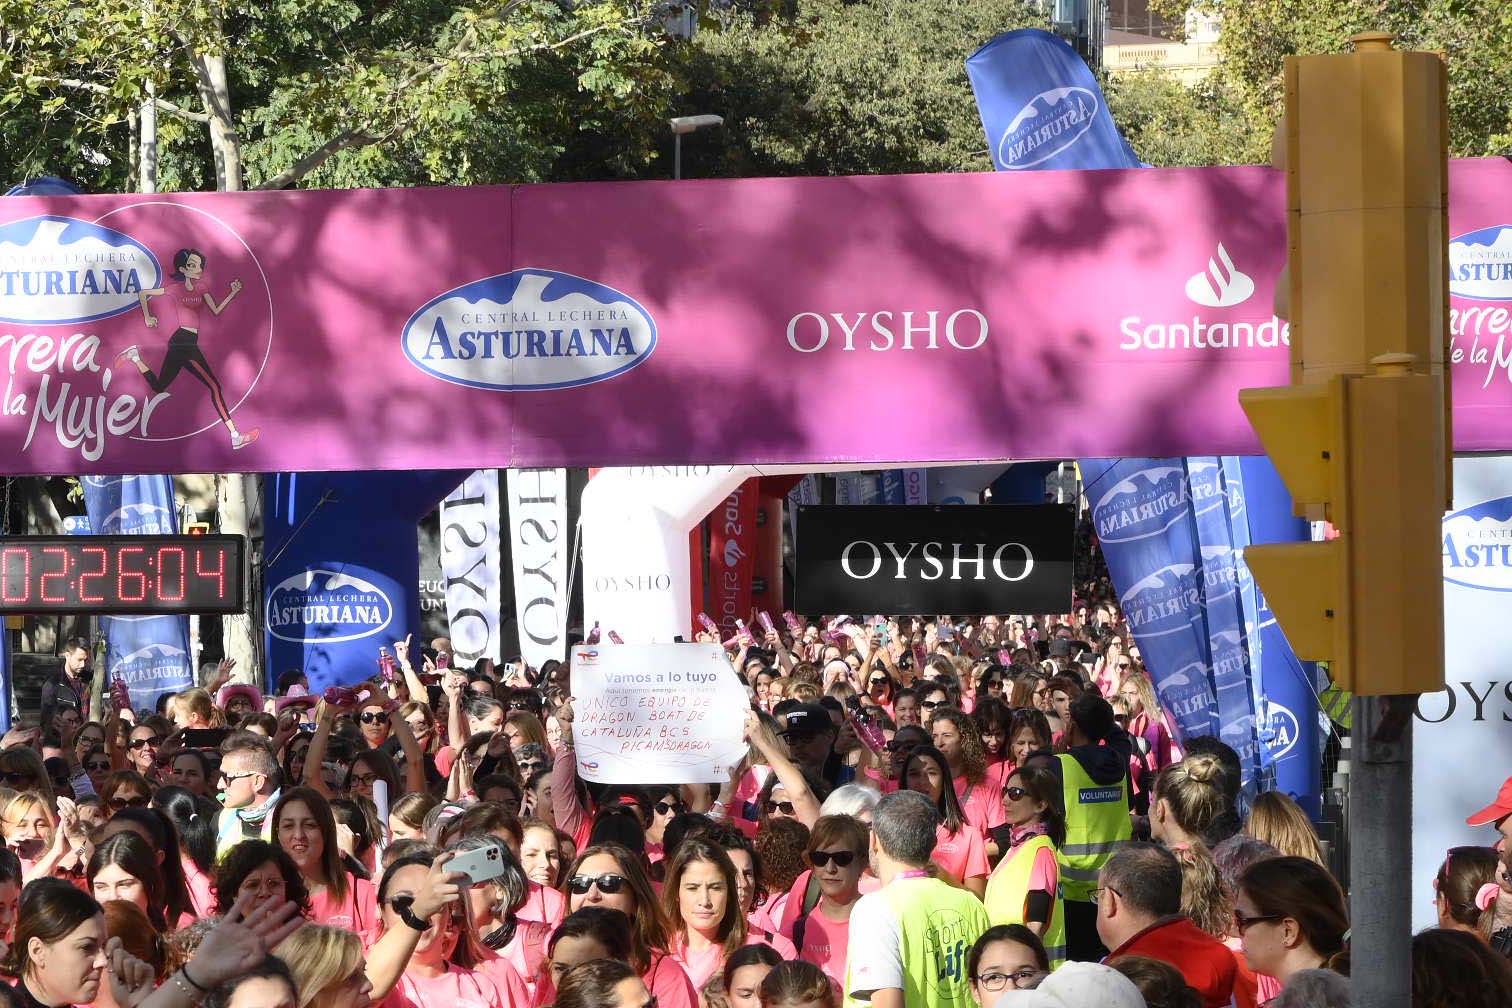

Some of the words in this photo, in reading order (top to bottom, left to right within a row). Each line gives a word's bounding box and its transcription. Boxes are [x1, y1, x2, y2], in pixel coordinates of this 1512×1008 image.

[65, 252, 137, 262] LECHERA
[1449, 263, 1512, 281] STUR
[461, 313, 538, 324] CENTRAL
[546, 310, 630, 322] LECHERA
[1450, 306, 1512, 336] arre
[423, 316, 637, 361] ASTURIANA
[786, 309, 989, 353] OYSHO
[1120, 317, 1290, 350] Santande
[1450, 338, 1465, 364] e
[1470, 335, 1488, 364] la
[1, 373, 26, 417] la
[23, 364, 171, 461] Mujer
[1467, 528, 1512, 539] CENT
[443, 468, 490, 662] OYSH
[518, 468, 559, 646] OYSH
[841, 540, 1034, 582] OYSHO
[1, 548, 225, 601] 02:26:04
[593, 574, 671, 593] OYSHO
[328, 594, 379, 603] LECHERA
[270, 600, 383, 626] ASTURIANA
[605, 672, 651, 684] Vamos
[656, 675, 664, 683] a
[669, 672, 682, 682] lo
[686, 672, 717, 684] tuyo
[693, 697, 712, 707] DE
[581, 711, 636, 724] DRAGON
[649, 710, 683, 721] BOAT
[687, 711, 706, 722] DE
